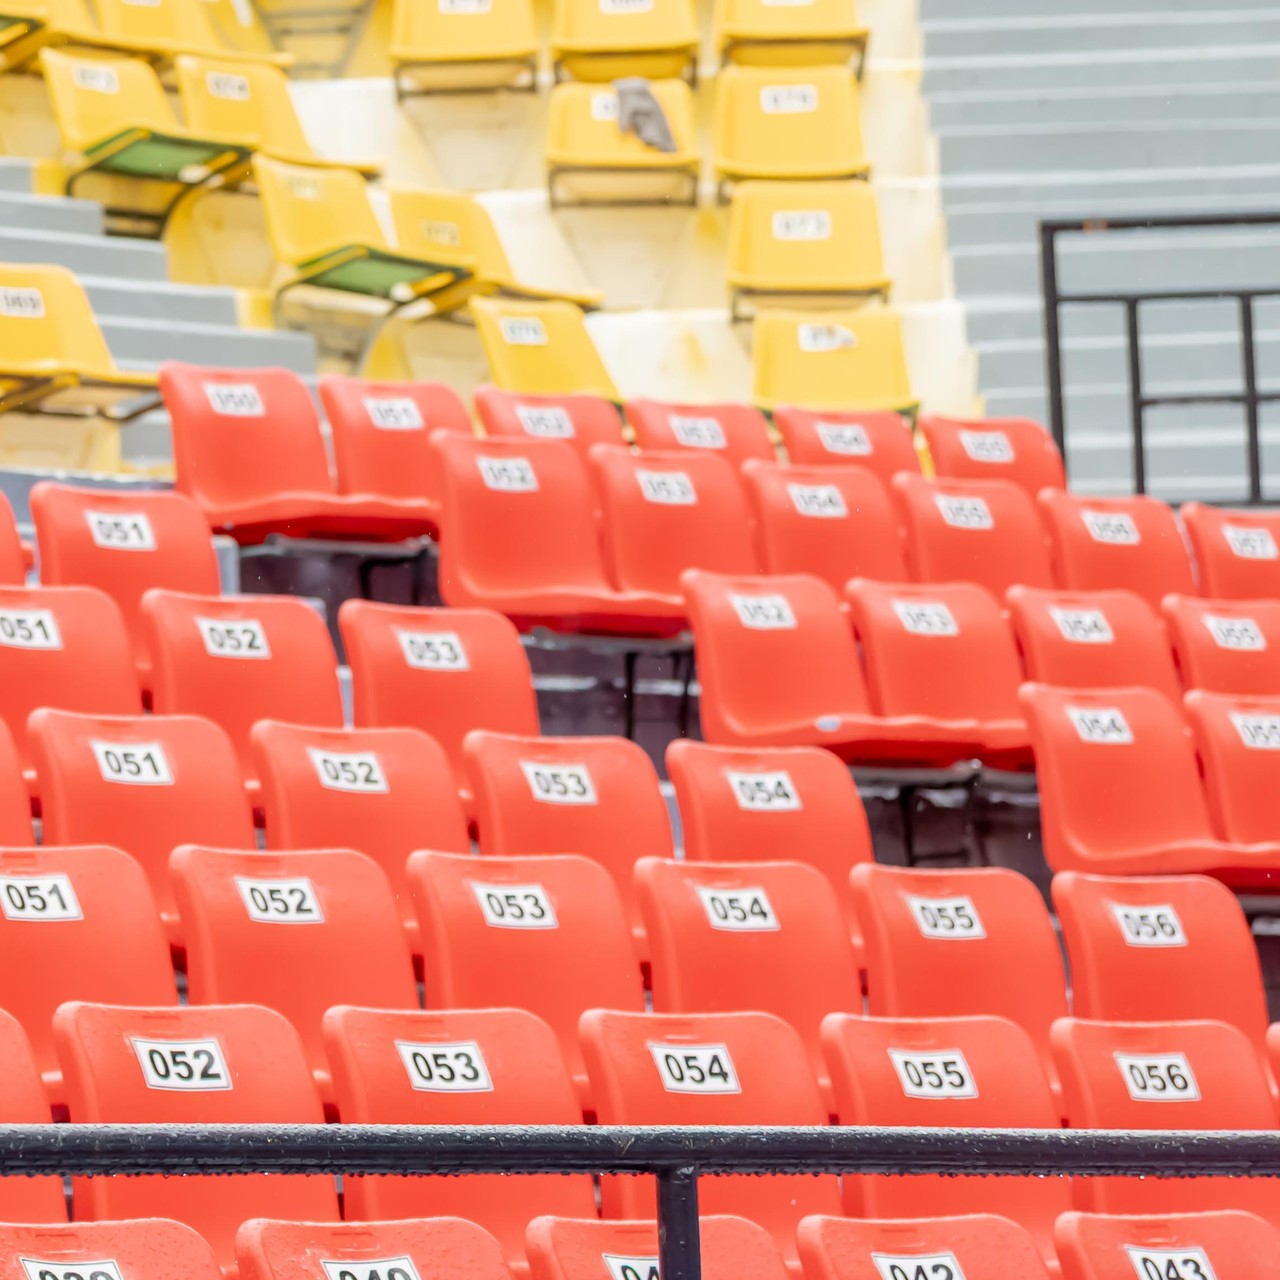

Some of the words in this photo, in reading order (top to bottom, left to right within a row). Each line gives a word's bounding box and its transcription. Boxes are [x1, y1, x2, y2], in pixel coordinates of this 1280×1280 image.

[97, 520, 144, 542] 051
[0, 617, 49, 641] 051
[209, 627, 261, 650] 052
[409, 639, 459, 663] 053
[105, 751, 159, 775] 051
[323, 759, 379, 784] 052
[535, 771, 587, 796] 053
[739, 781, 790, 803] 054
[6, 884, 67, 912] 051
[250, 888, 312, 914] 052
[486, 893, 545, 919] 053
[711, 897, 768, 922] 054
[921, 906, 974, 930] 055
[1124, 914, 1176, 937] 056
[149, 1050, 221, 1081] 052
[412, 1052, 479, 1082] 053
[665, 1054, 728, 1084] 054
[904, 1061, 965, 1089] 055
[1129, 1064, 1188, 1091] 056
[1142, 1257, 1207, 1280] 043
